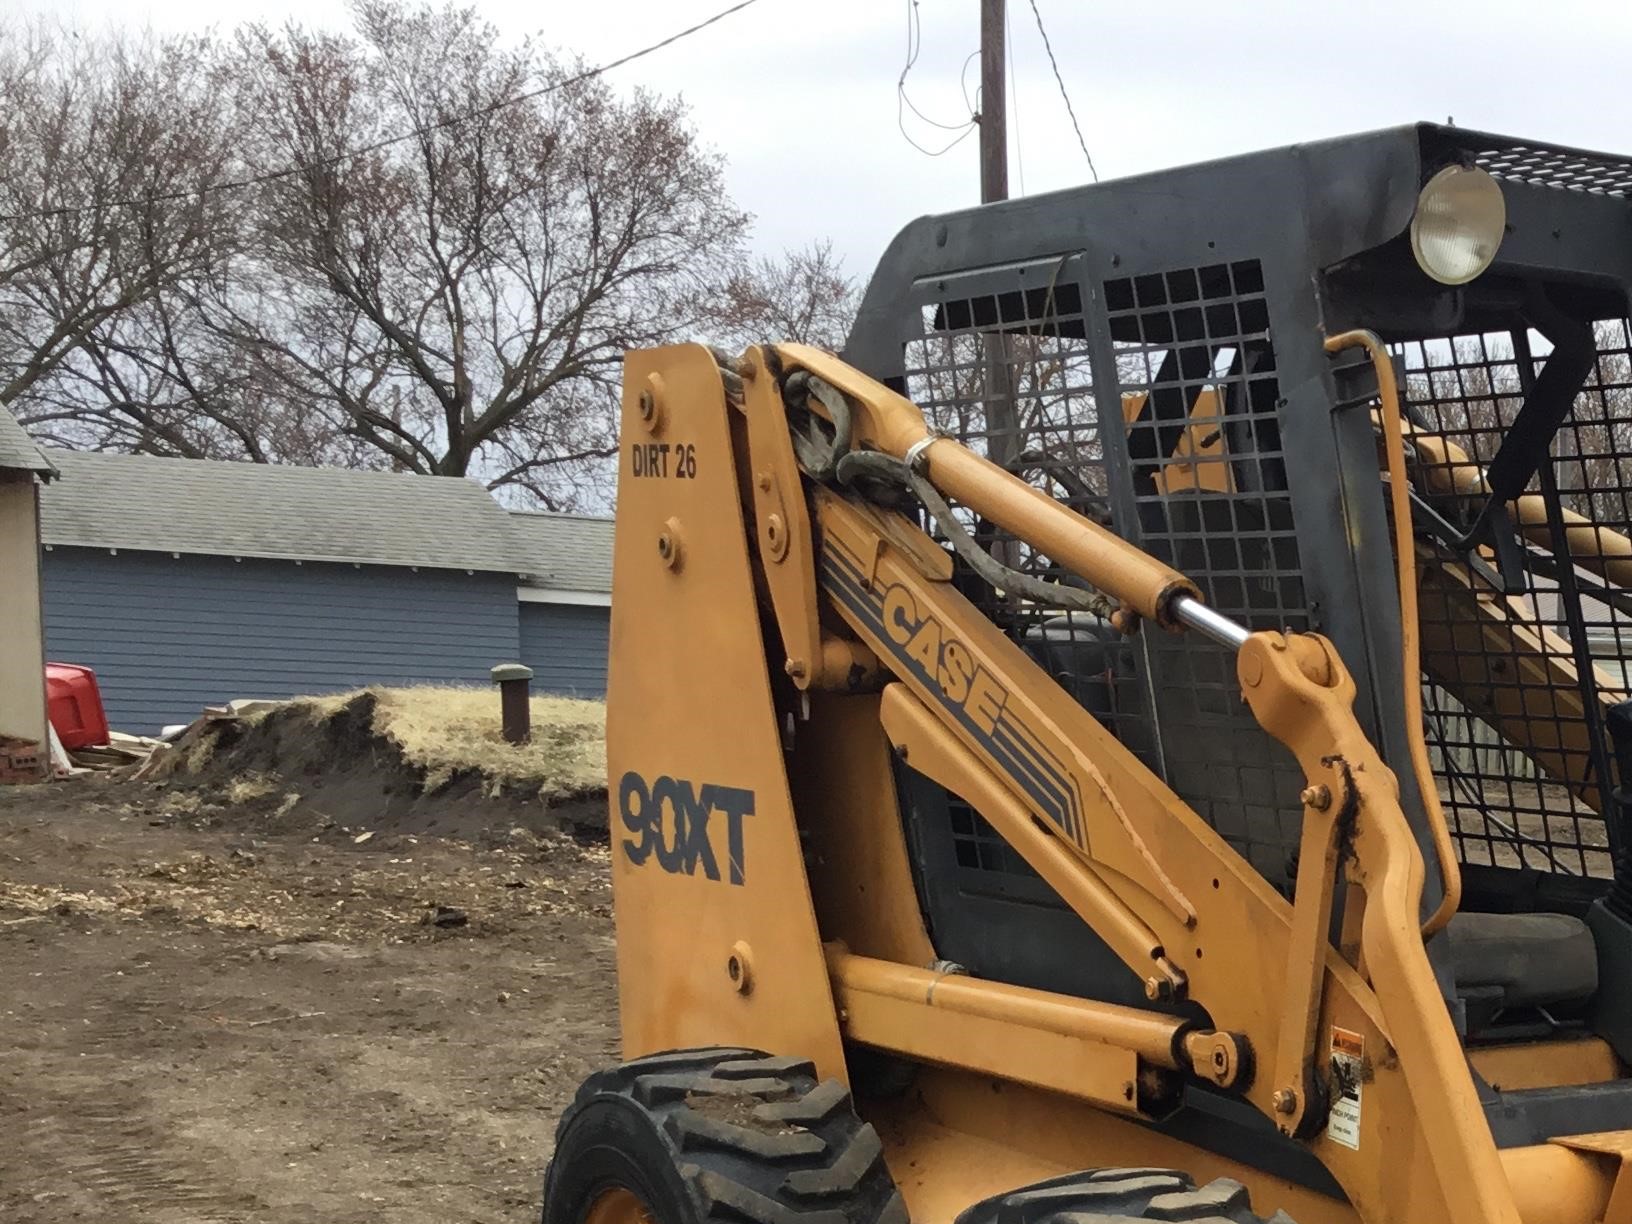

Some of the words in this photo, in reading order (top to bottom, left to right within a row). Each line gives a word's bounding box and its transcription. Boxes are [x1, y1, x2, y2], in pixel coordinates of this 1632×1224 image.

[632, 443, 670, 478] DIRT
[675, 443, 697, 479] 26
[883, 583, 1009, 737] CASE
[619, 771, 756, 887] 90XT
